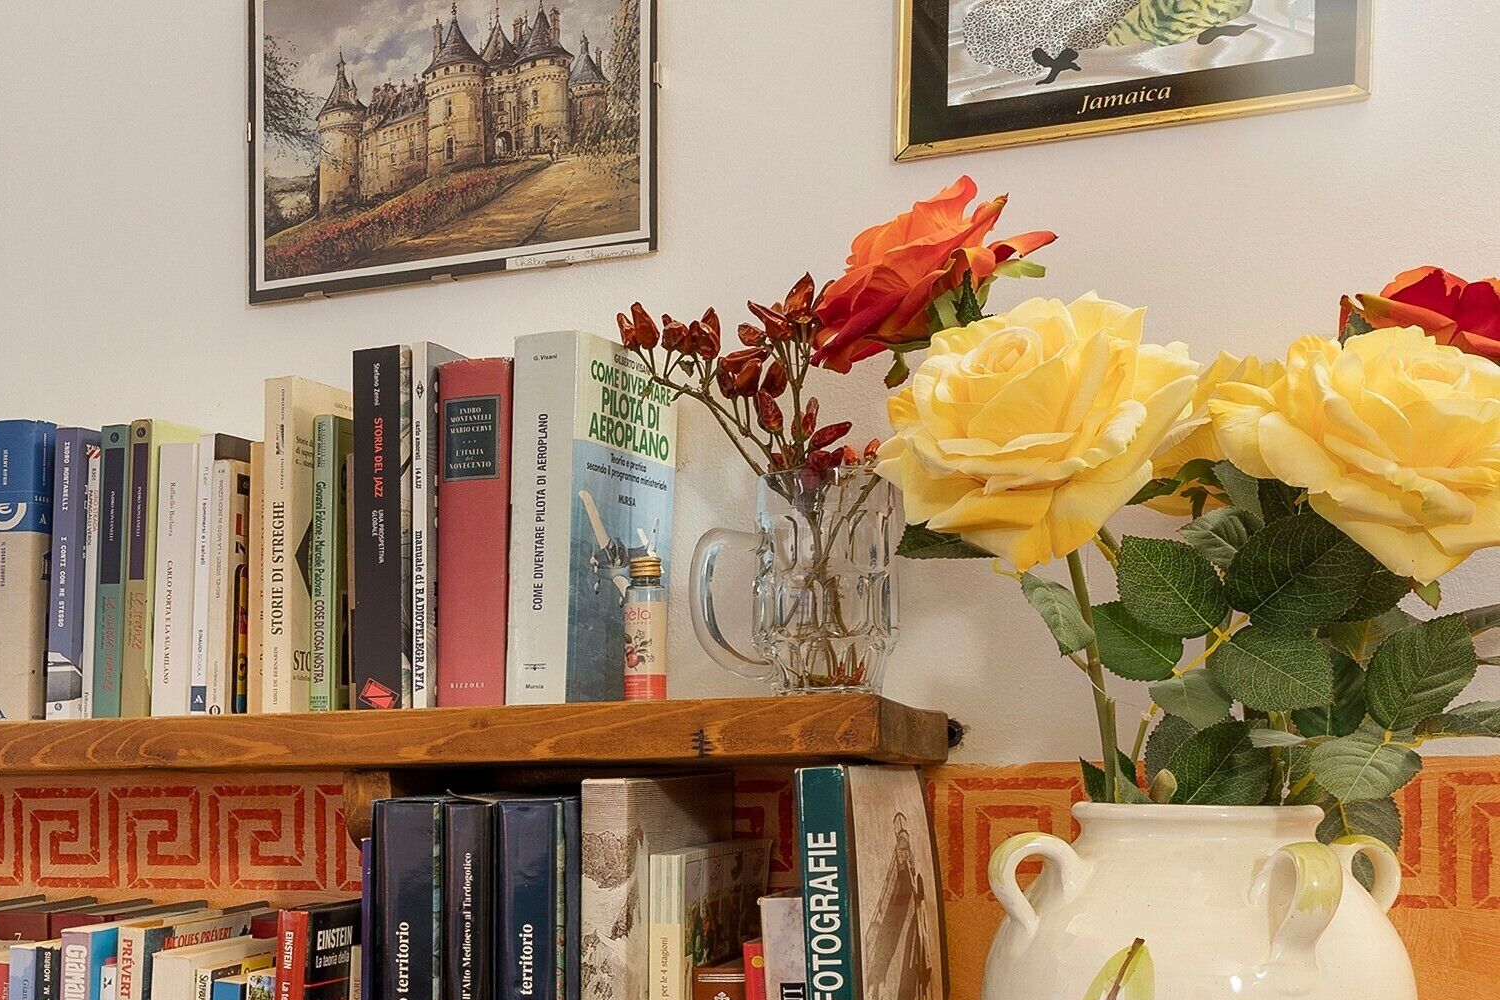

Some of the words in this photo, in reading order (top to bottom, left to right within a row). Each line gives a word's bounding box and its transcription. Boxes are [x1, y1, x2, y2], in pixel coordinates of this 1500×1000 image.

[1076, 86, 1171, 115] Jamaica
[450, 414, 491, 423] MONTANELLI
[602, 386, 644, 427] PILOTA
[648, 403, 659, 431] DI
[374, 417, 383, 452] STORIA
[536, 413, 548, 471] AEROPLANO
[589, 412, 669, 461] AEROPLANO
[374, 456, 383, 473] DEL
[449, 461, 491, 470] NOVECENTO
[373, 477, 383, 498] JAZZ
[536, 475, 546, 485] DI
[315, 481, 326, 510] Giovanni
[535, 489, 546, 522] PILOTA
[272, 502, 284, 563] STREGHE
[315, 510, 326, 535] Falcone
[414, 530, 424, 572] manuale
[534, 526, 545, 579] DIVENTARE
[272, 569, 284, 582] DI
[414, 574, 424, 585] di
[314, 600, 324, 620] COSE
[533, 583, 543, 610] COME
[271, 588, 283, 635] STORIE
[314, 621, 324, 629] DI
[314, 630, 324, 651] COSA
[414, 587, 424, 692] RADIOTELEGRAFIA
[313, 652, 324, 684] NOSTRA
[462, 852, 473, 907] Tardogotico
[462, 911, 471, 920] al
[283, 931, 294, 969] EINSTEIN
[316, 925, 353, 950] EINSTEIN
[462, 921, 471, 967] Medioevo
[120, 938, 135, 999] PRÉVERT
[315, 955, 322, 968] La
[322, 954, 337, 967] teoria
[337, 952, 350, 963] della
[395, 921, 409, 993] territorio
[518, 923, 533, 995] territorio
[282, 982, 290, 991] La
